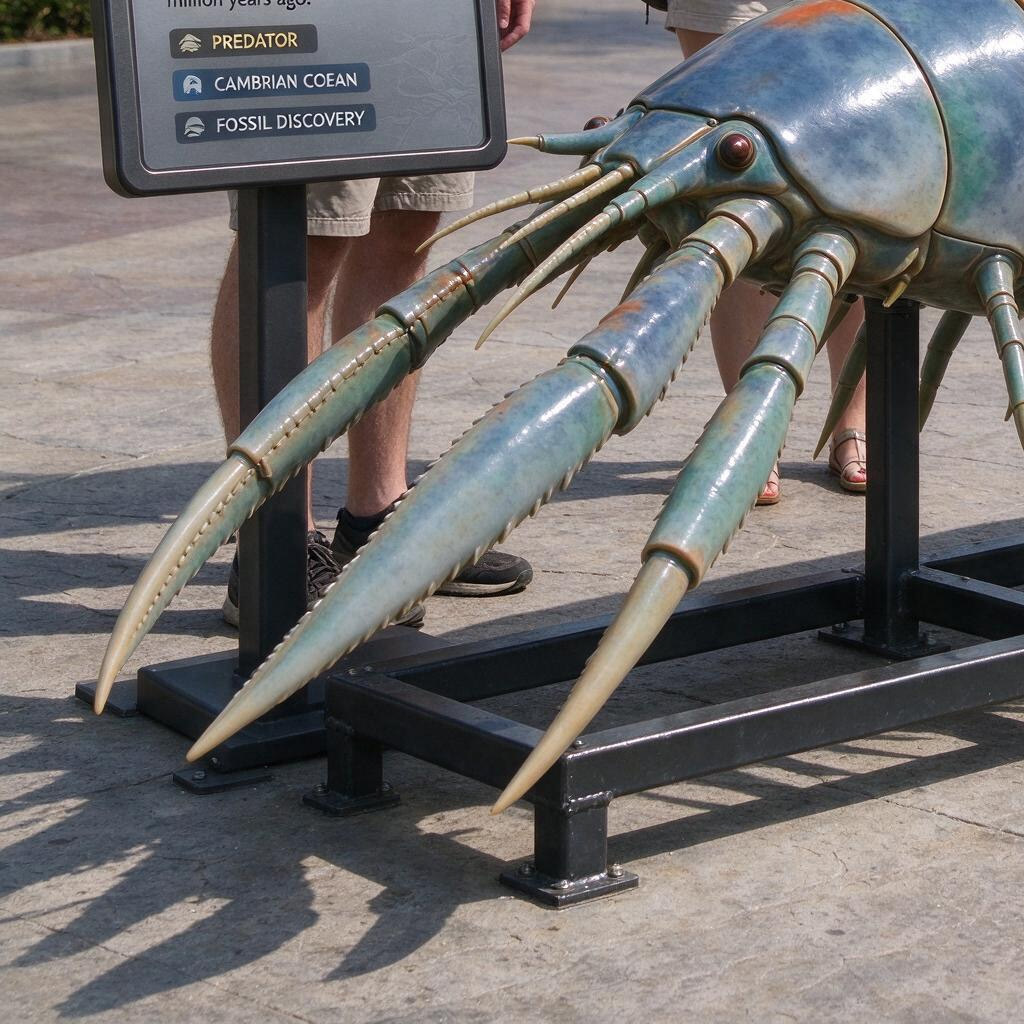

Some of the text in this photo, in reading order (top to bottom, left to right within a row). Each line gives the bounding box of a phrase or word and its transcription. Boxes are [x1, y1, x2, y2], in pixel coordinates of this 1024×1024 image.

[212, 32, 298, 50] PREDATOR
[214, 72, 358, 92] CAMBRIAN COEAN
[216, 110, 365, 133] FOSSIL DISCOVERY
